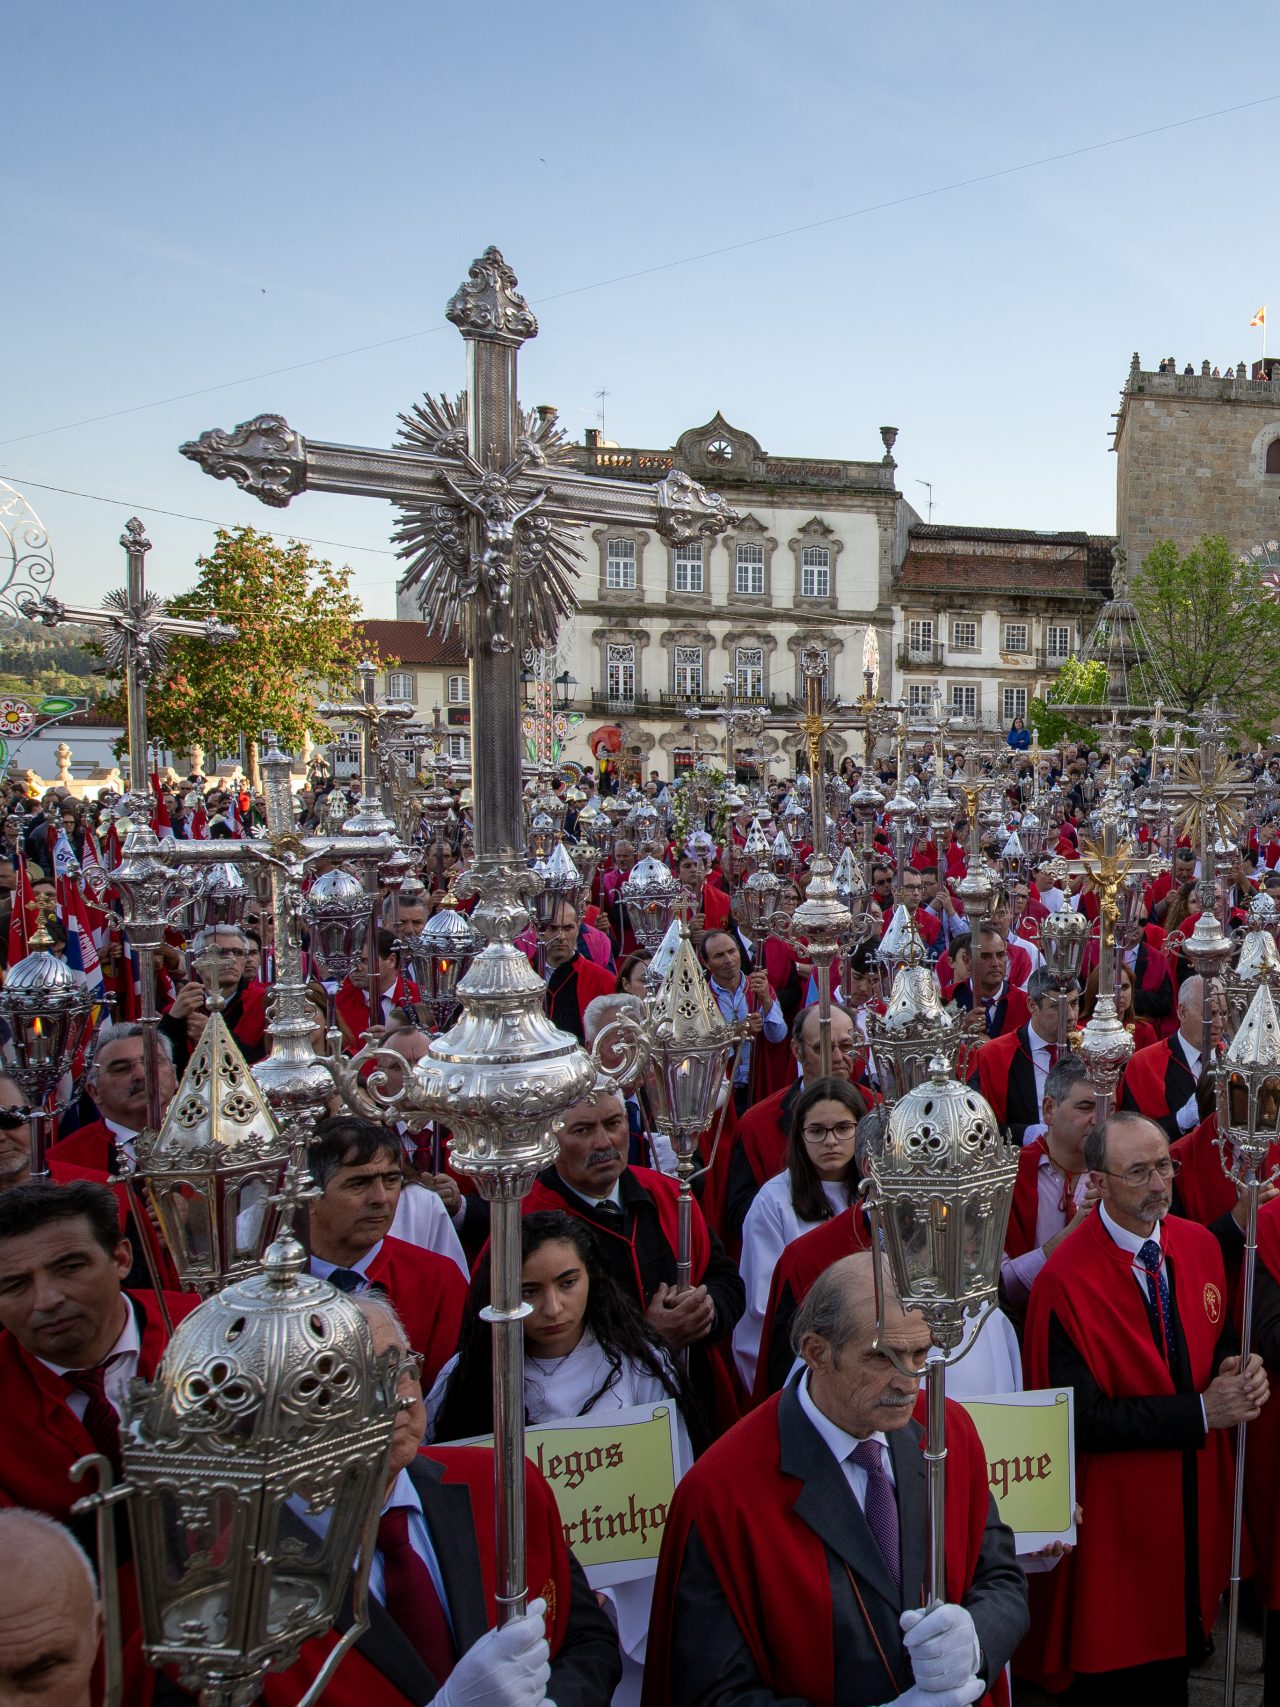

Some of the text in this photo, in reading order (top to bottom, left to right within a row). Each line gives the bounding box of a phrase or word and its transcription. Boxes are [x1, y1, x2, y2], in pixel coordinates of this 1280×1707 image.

[666, 694, 687, 702] ESCOLA
[690, 695, 697, 703] DE
[732, 697, 768, 705] BARCELENSE
[536, 1442, 623, 1489] legos
[986, 1452, 1052, 1500] que
[562, 1493, 669, 1548] rtinho
